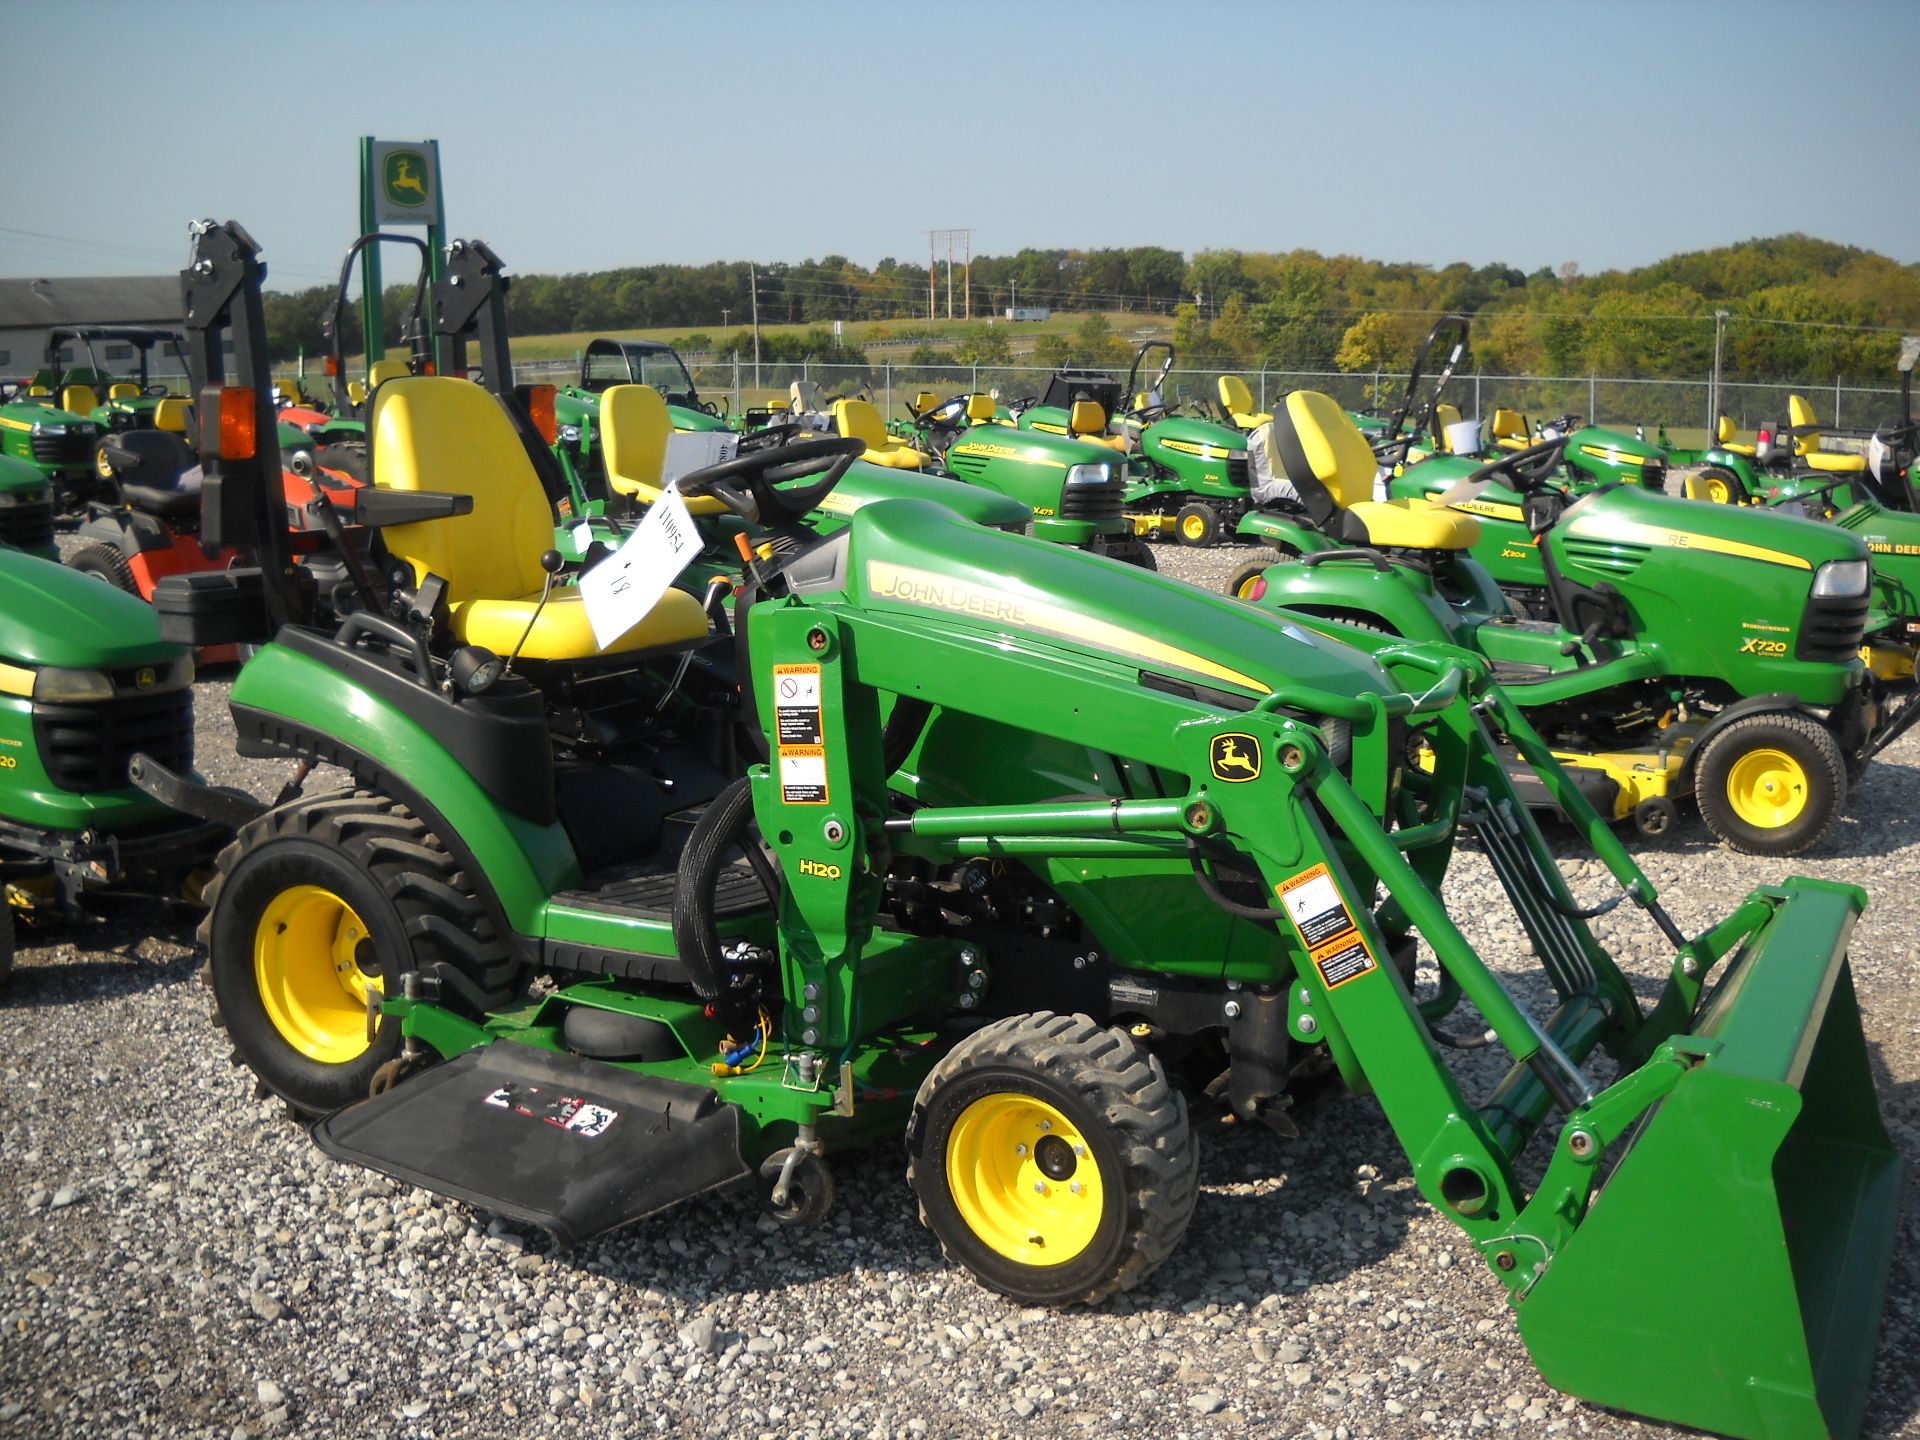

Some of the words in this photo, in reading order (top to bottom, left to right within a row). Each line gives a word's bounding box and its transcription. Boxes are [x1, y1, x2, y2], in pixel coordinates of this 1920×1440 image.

[719, 444, 729, 463] 408
[1033, 506, 1054, 516] X475
[1867, 543, 1892, 553] OHN
[1895, 545, 1920, 555] DEE
[885, 576, 945, 604] JOHN
[950, 587, 1026, 622] DEERE
[1739, 637, 1788, 654] X720
[783, 666, 818, 674] WARNING
[787, 748, 822, 756] WARNING
[0, 755, 17, 769] 20
[799, 859, 842, 880] H120
[1289, 868, 1321, 888] WARNING
[1324, 936, 1357, 956] WARNING
